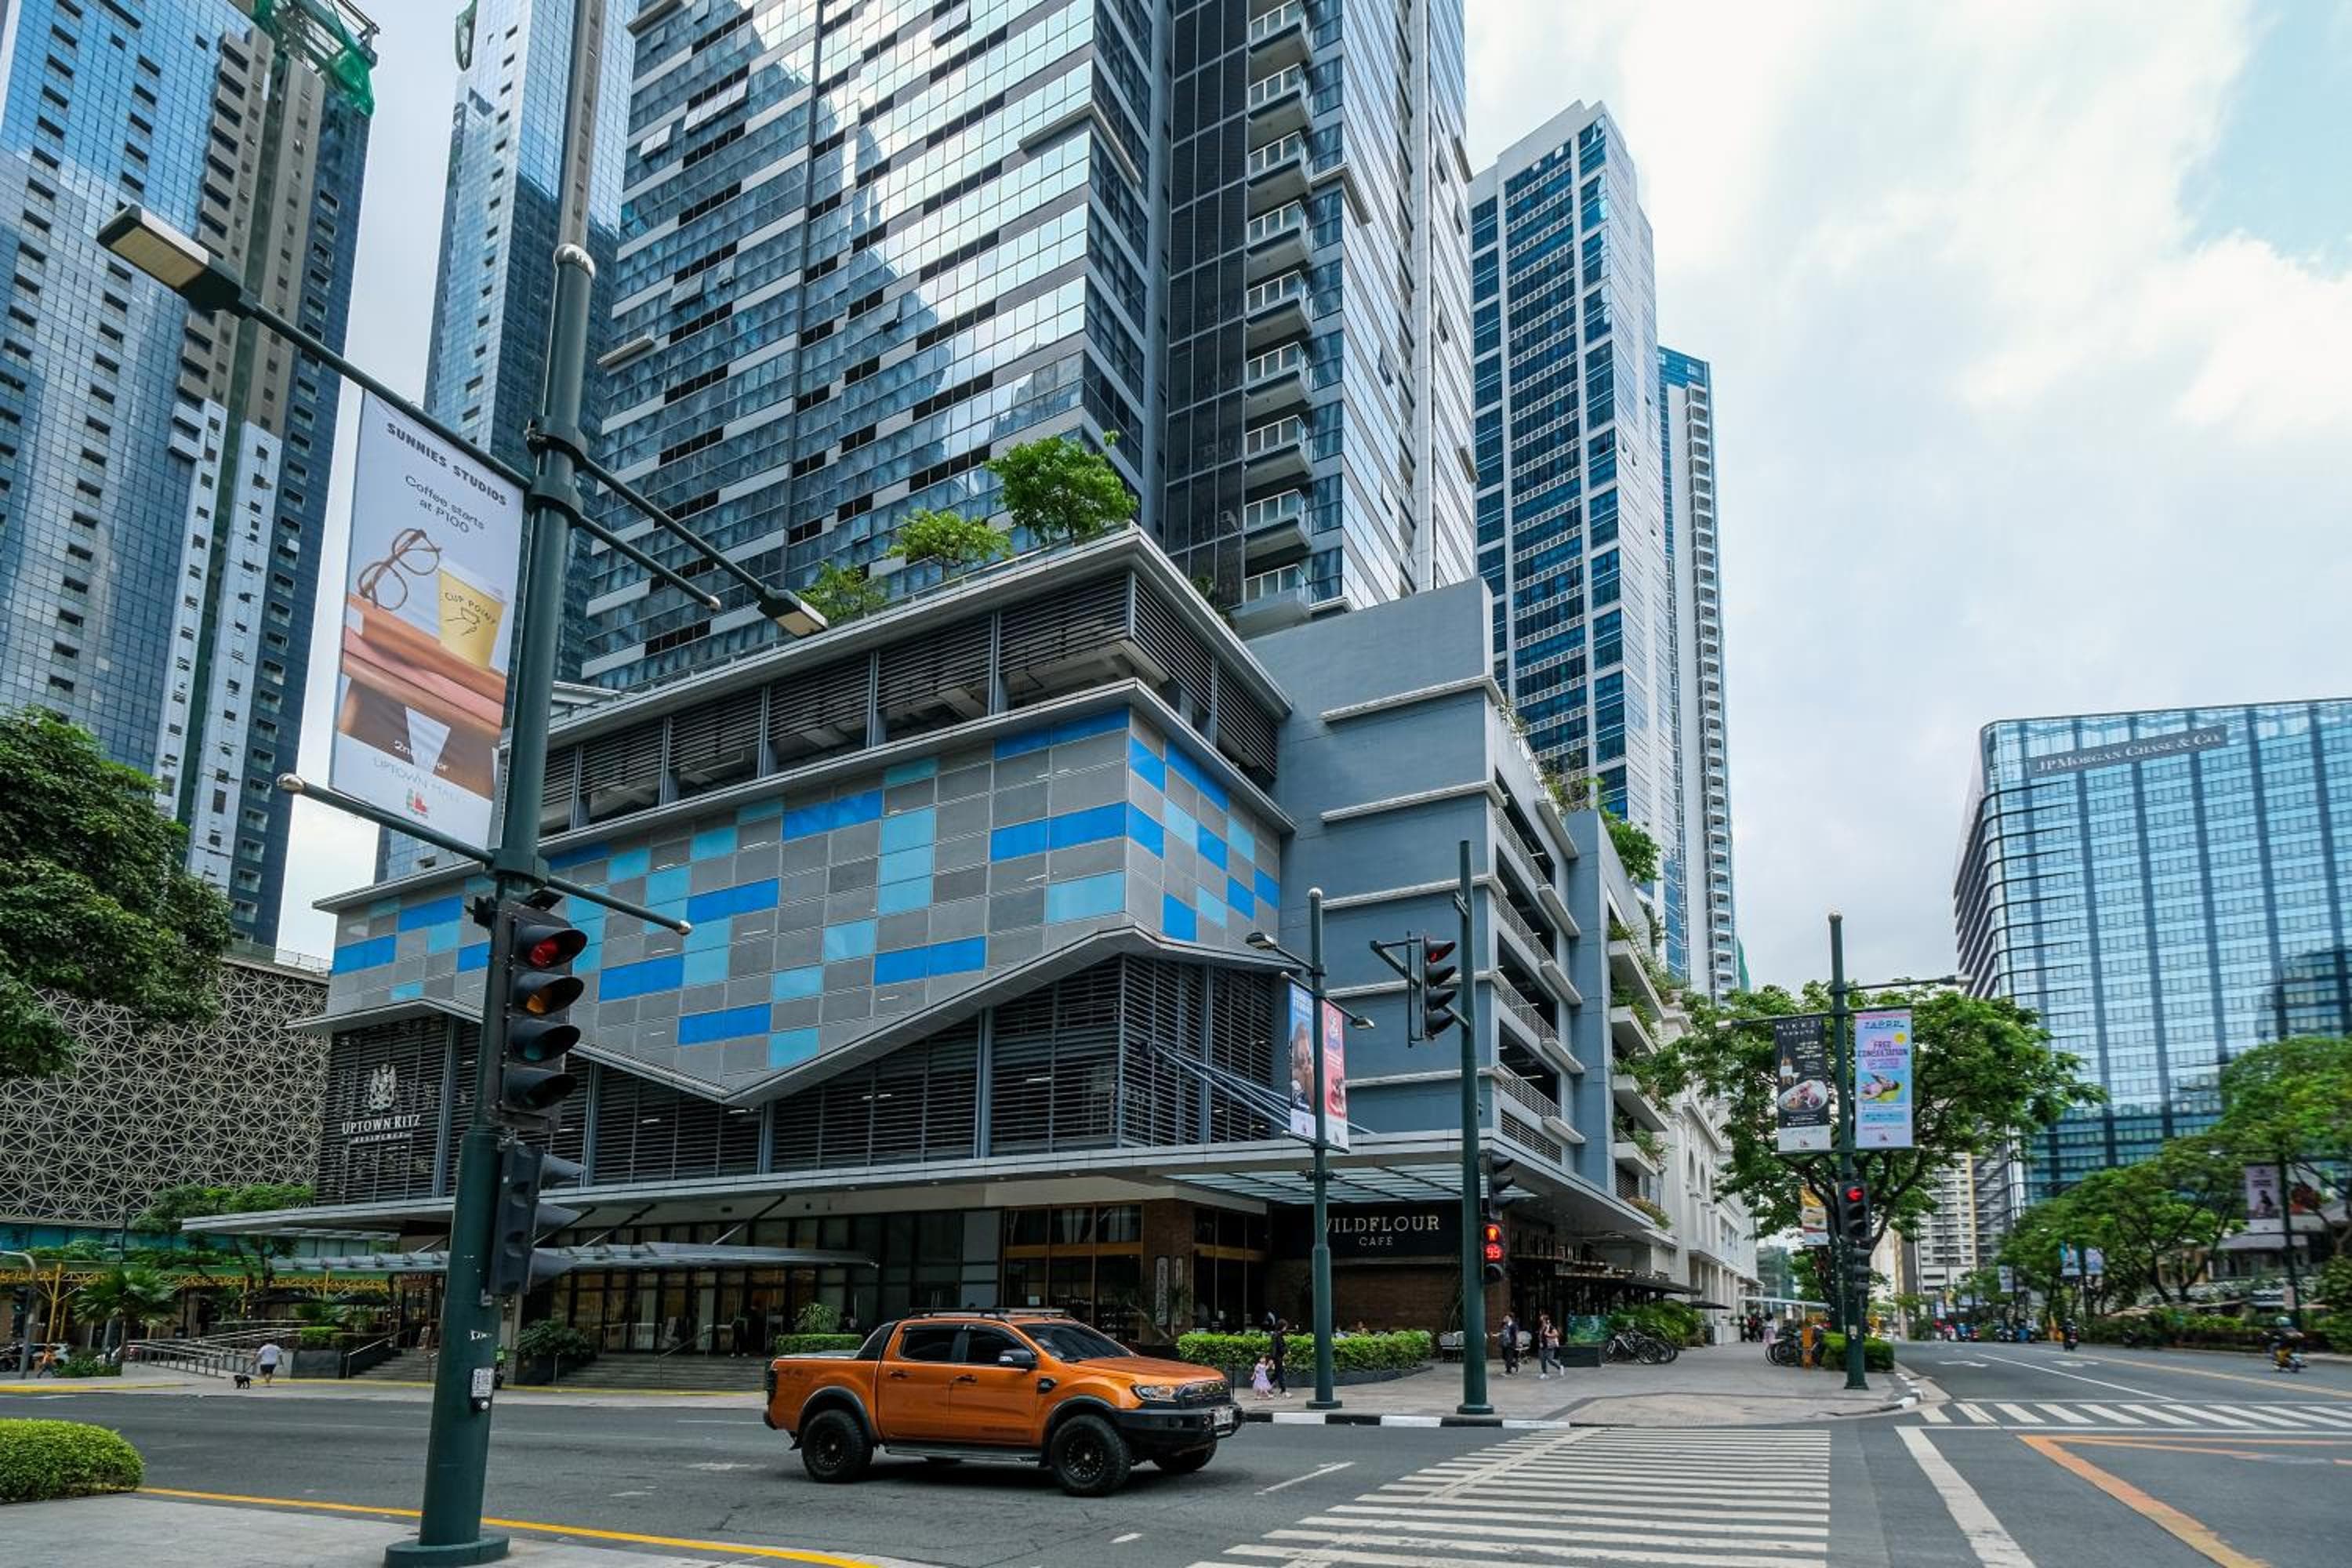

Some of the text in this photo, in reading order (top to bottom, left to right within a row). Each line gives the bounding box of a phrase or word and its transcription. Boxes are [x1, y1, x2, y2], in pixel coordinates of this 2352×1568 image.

[387, 422, 506, 506] SUNNIES STUDIOS
[405, 475, 485, 529] Coffee starts
[419, 499, 432, 511] at
[342, 1114, 421, 1134] UPTOWN RITZ
